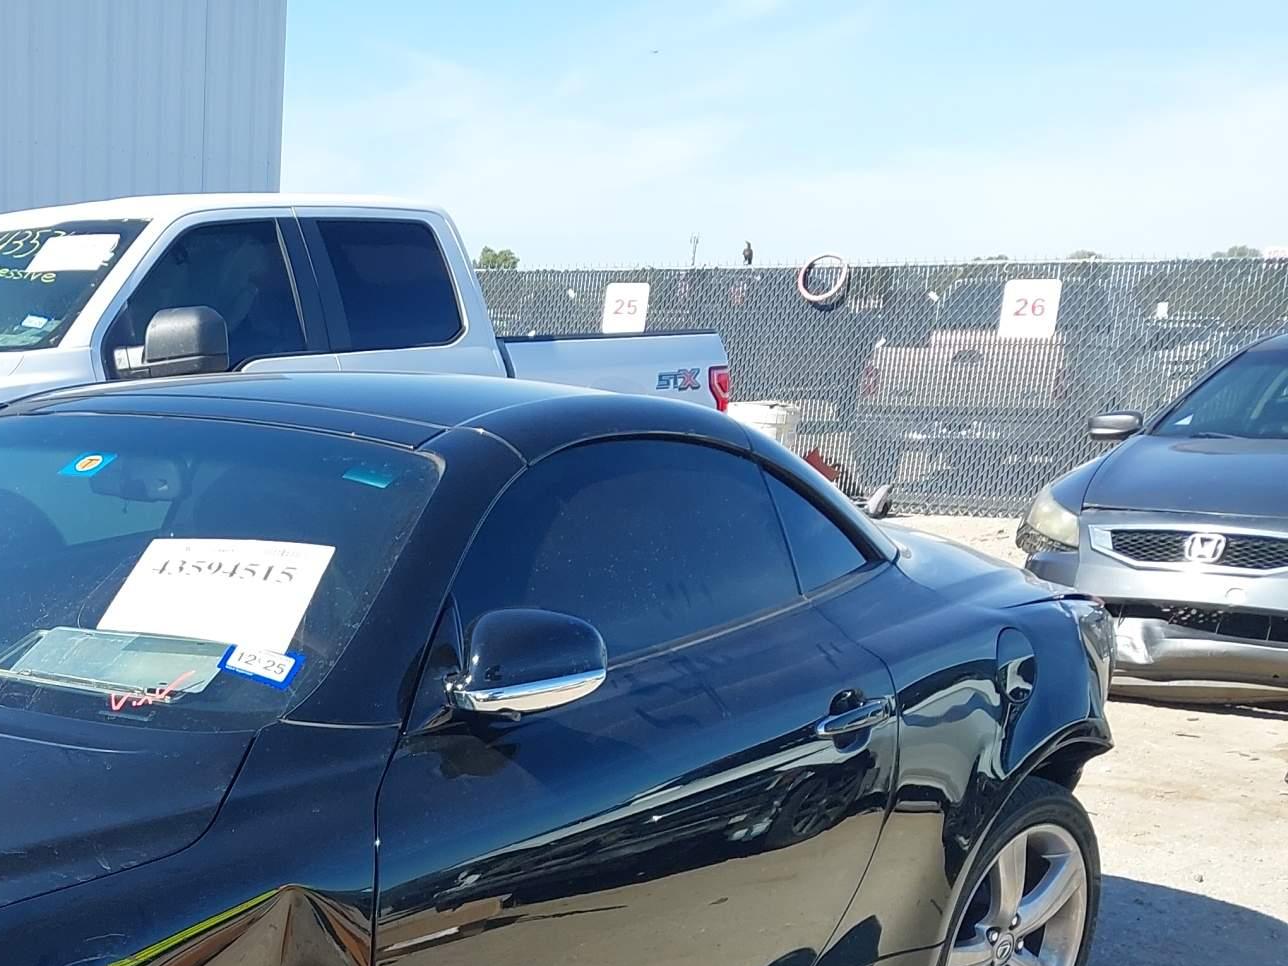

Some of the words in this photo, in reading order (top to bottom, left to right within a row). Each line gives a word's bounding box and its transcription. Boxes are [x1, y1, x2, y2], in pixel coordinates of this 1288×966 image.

[613, 298, 638, 315] 25
[1013, 297, 1046, 317] 26
[656, 367, 701, 392] STX
[152, 559, 297, 583] 43594515
[263, 659, 287, 675] 25
